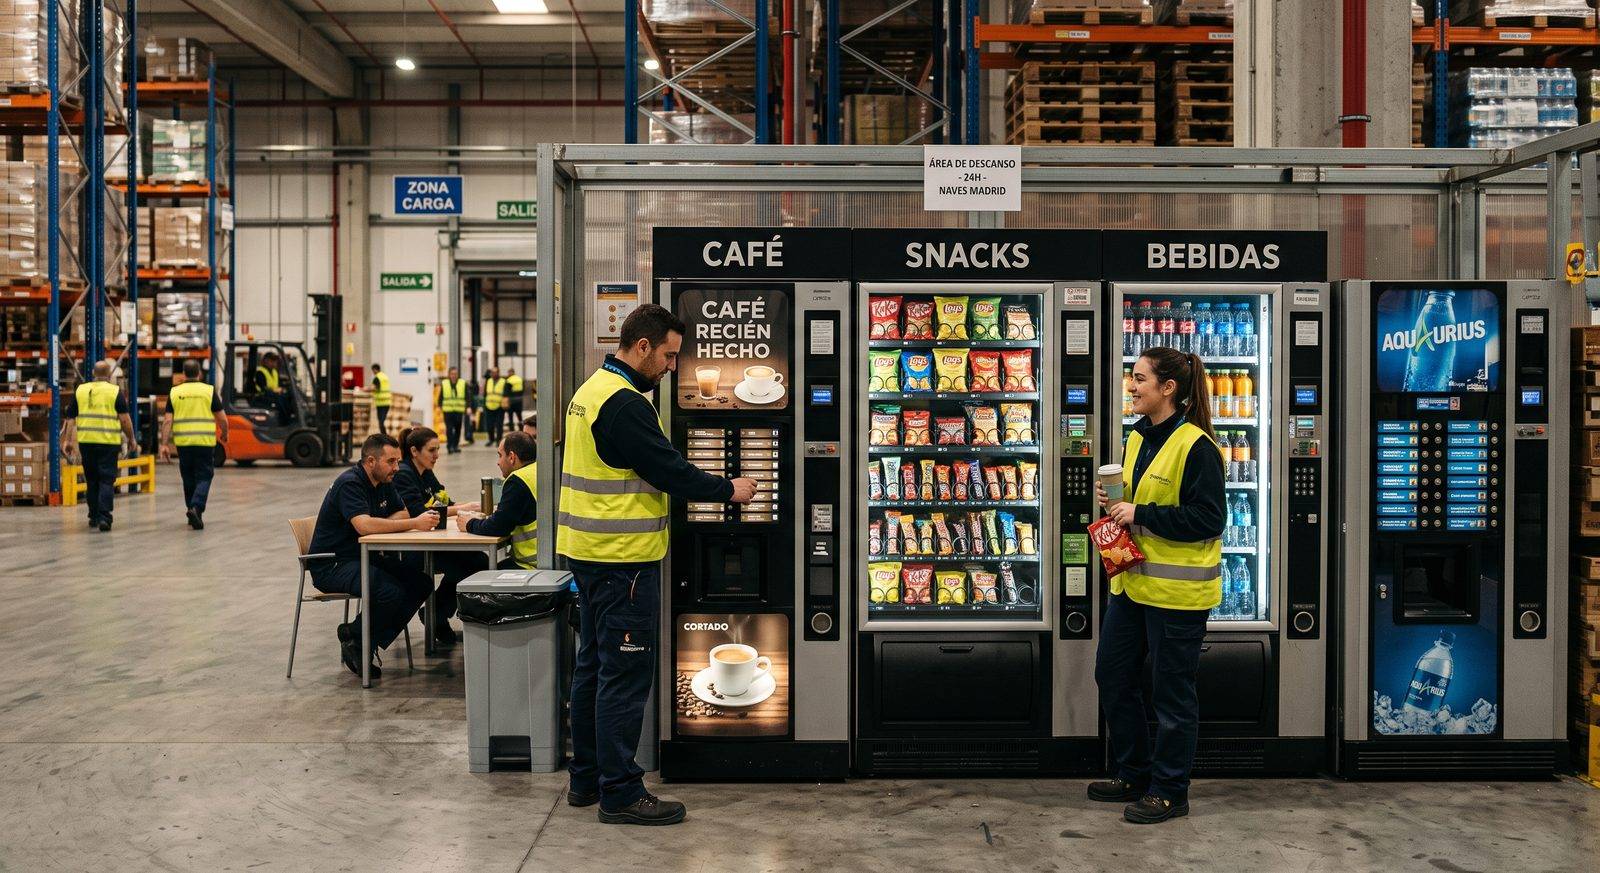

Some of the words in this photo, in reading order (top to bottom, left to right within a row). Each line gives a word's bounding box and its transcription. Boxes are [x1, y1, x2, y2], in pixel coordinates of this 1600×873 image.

[929, 157, 953, 168] ÁREA
[955, 159, 967, 168] DE
[969, 159, 1016, 168] DESCANSO
[964, 173, 981, 181] 24H
[407, 181, 449, 194] ZONA
[939, 186, 967, 195] NAVES
[970, 186, 1006, 195] MADRID
[402, 197, 455, 210] CARGA
[702, 234, 784, 267] CAFÉ
[905, 242, 1030, 269] SNACKS
[1147, 242, 1281, 270] BEBIDAS
[383, 276, 416, 287] SALIDA
[701, 296, 765, 319] CAFÉ
[696, 320, 771, 339] RECIÉN
[697, 343, 770, 359] HECHO
[683, 622, 729, 631] CORTADO
